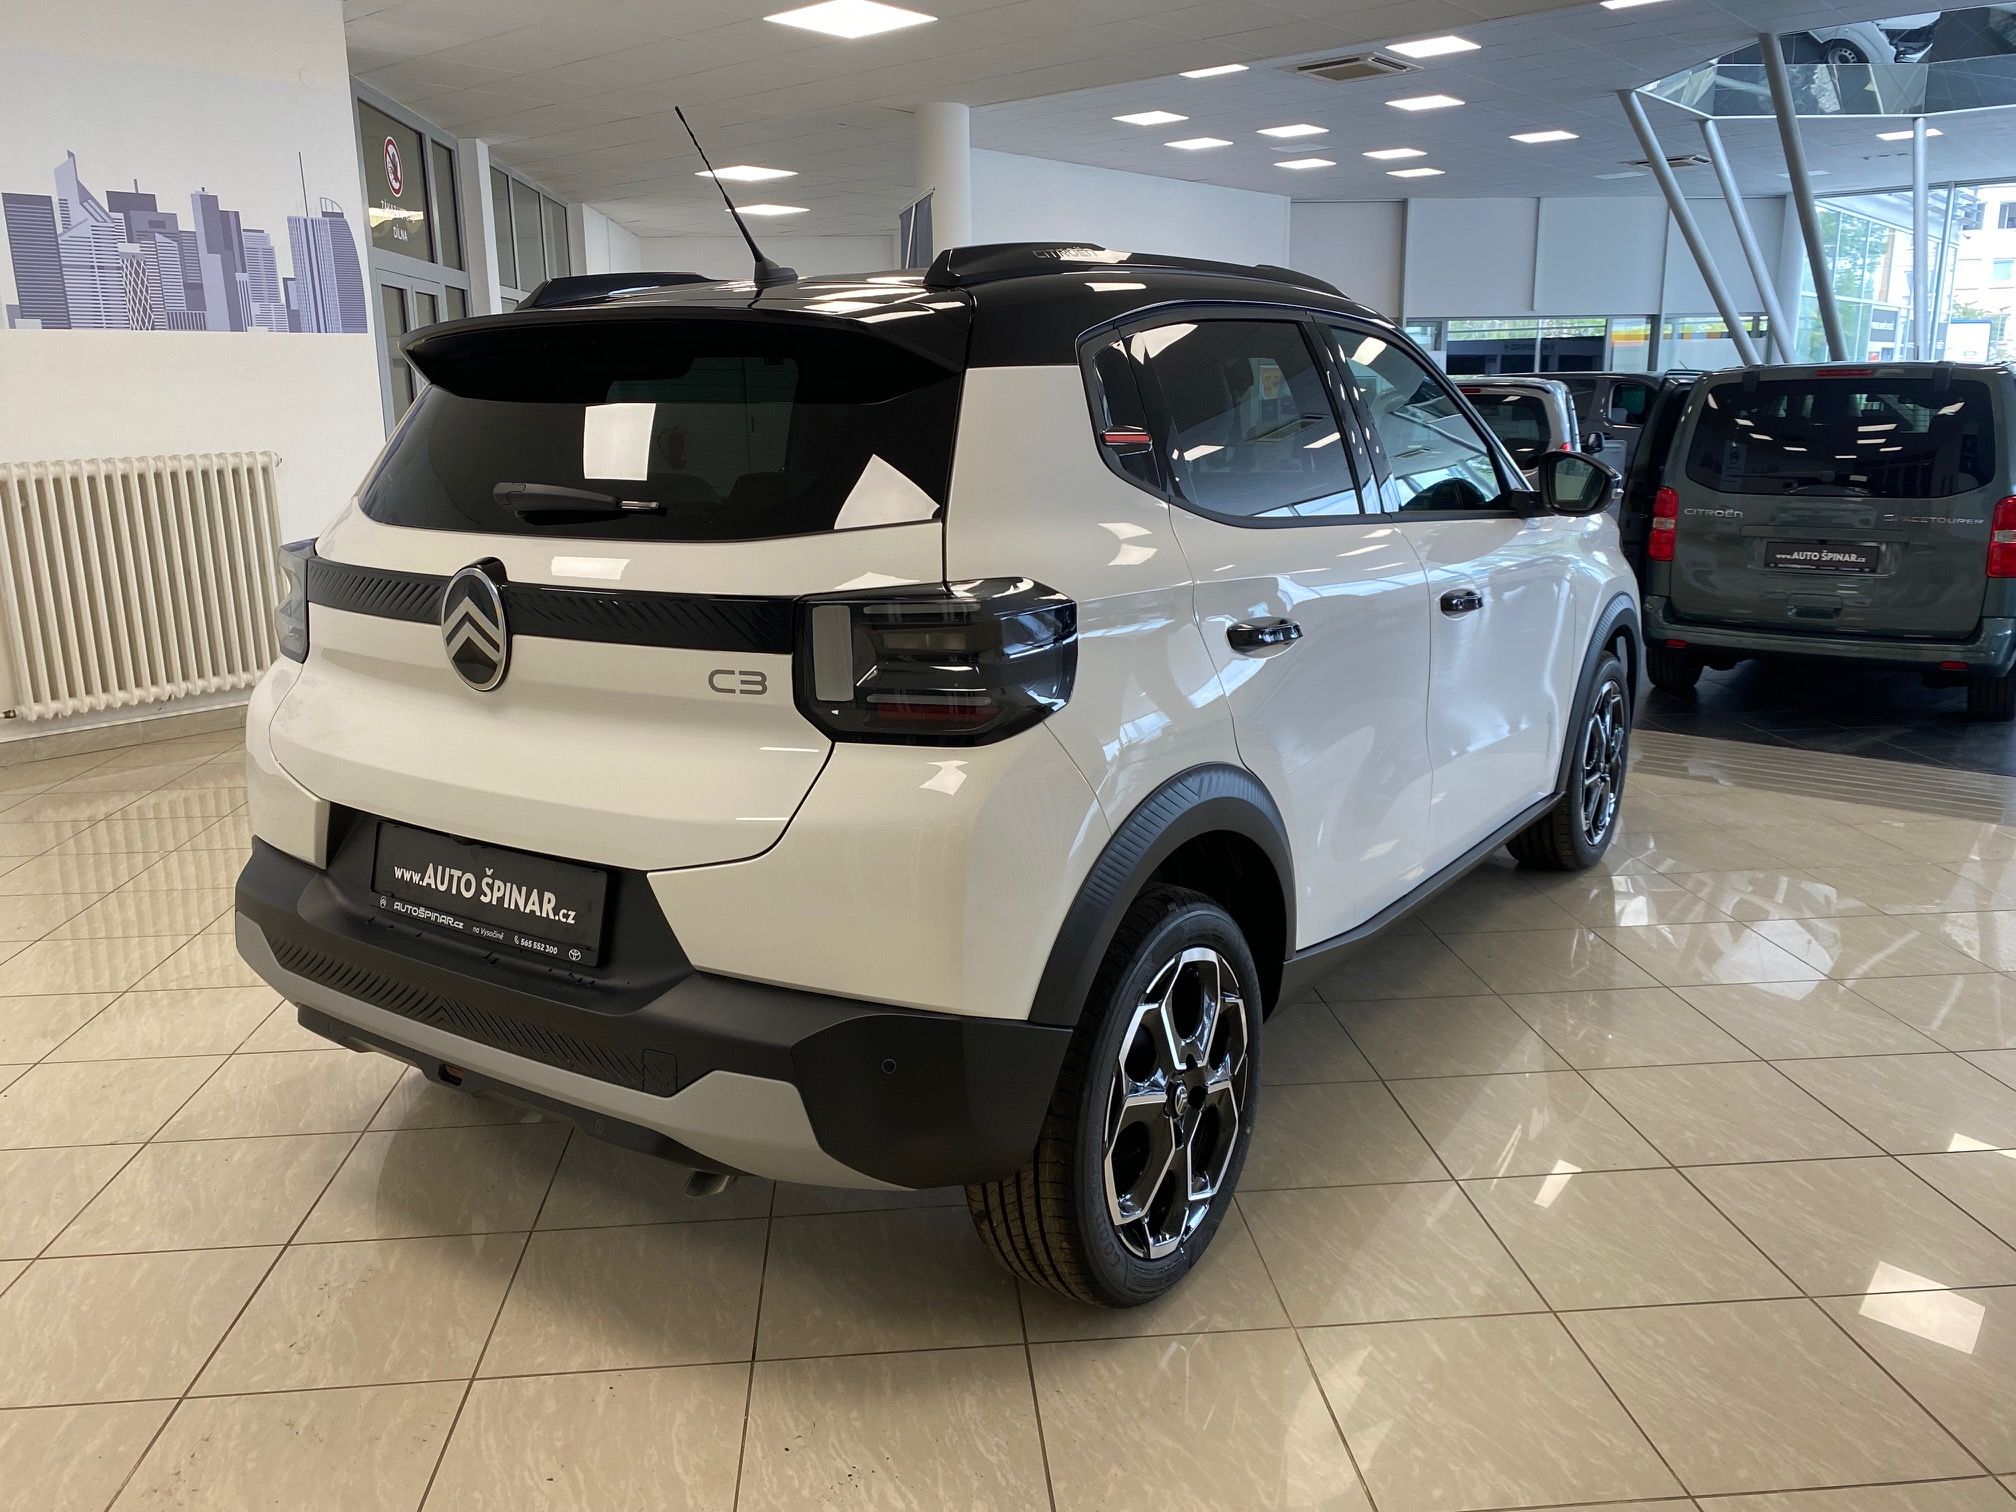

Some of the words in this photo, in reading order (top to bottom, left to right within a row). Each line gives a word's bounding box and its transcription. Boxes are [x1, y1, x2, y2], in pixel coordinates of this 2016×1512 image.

[1684, 507, 1743, 519] CITROËN
[1775, 551, 1820, 561] www.AUTO
[708, 669, 767, 695] C3
[394, 862, 476, 899] www.AUTO
[480, 867, 576, 924] ŠPINAR.cz
[472, 926, 480, 934] na
[520, 938, 533, 949] 565
[532, 941, 545, 952] 552
[545, 944, 558, 955] 300
